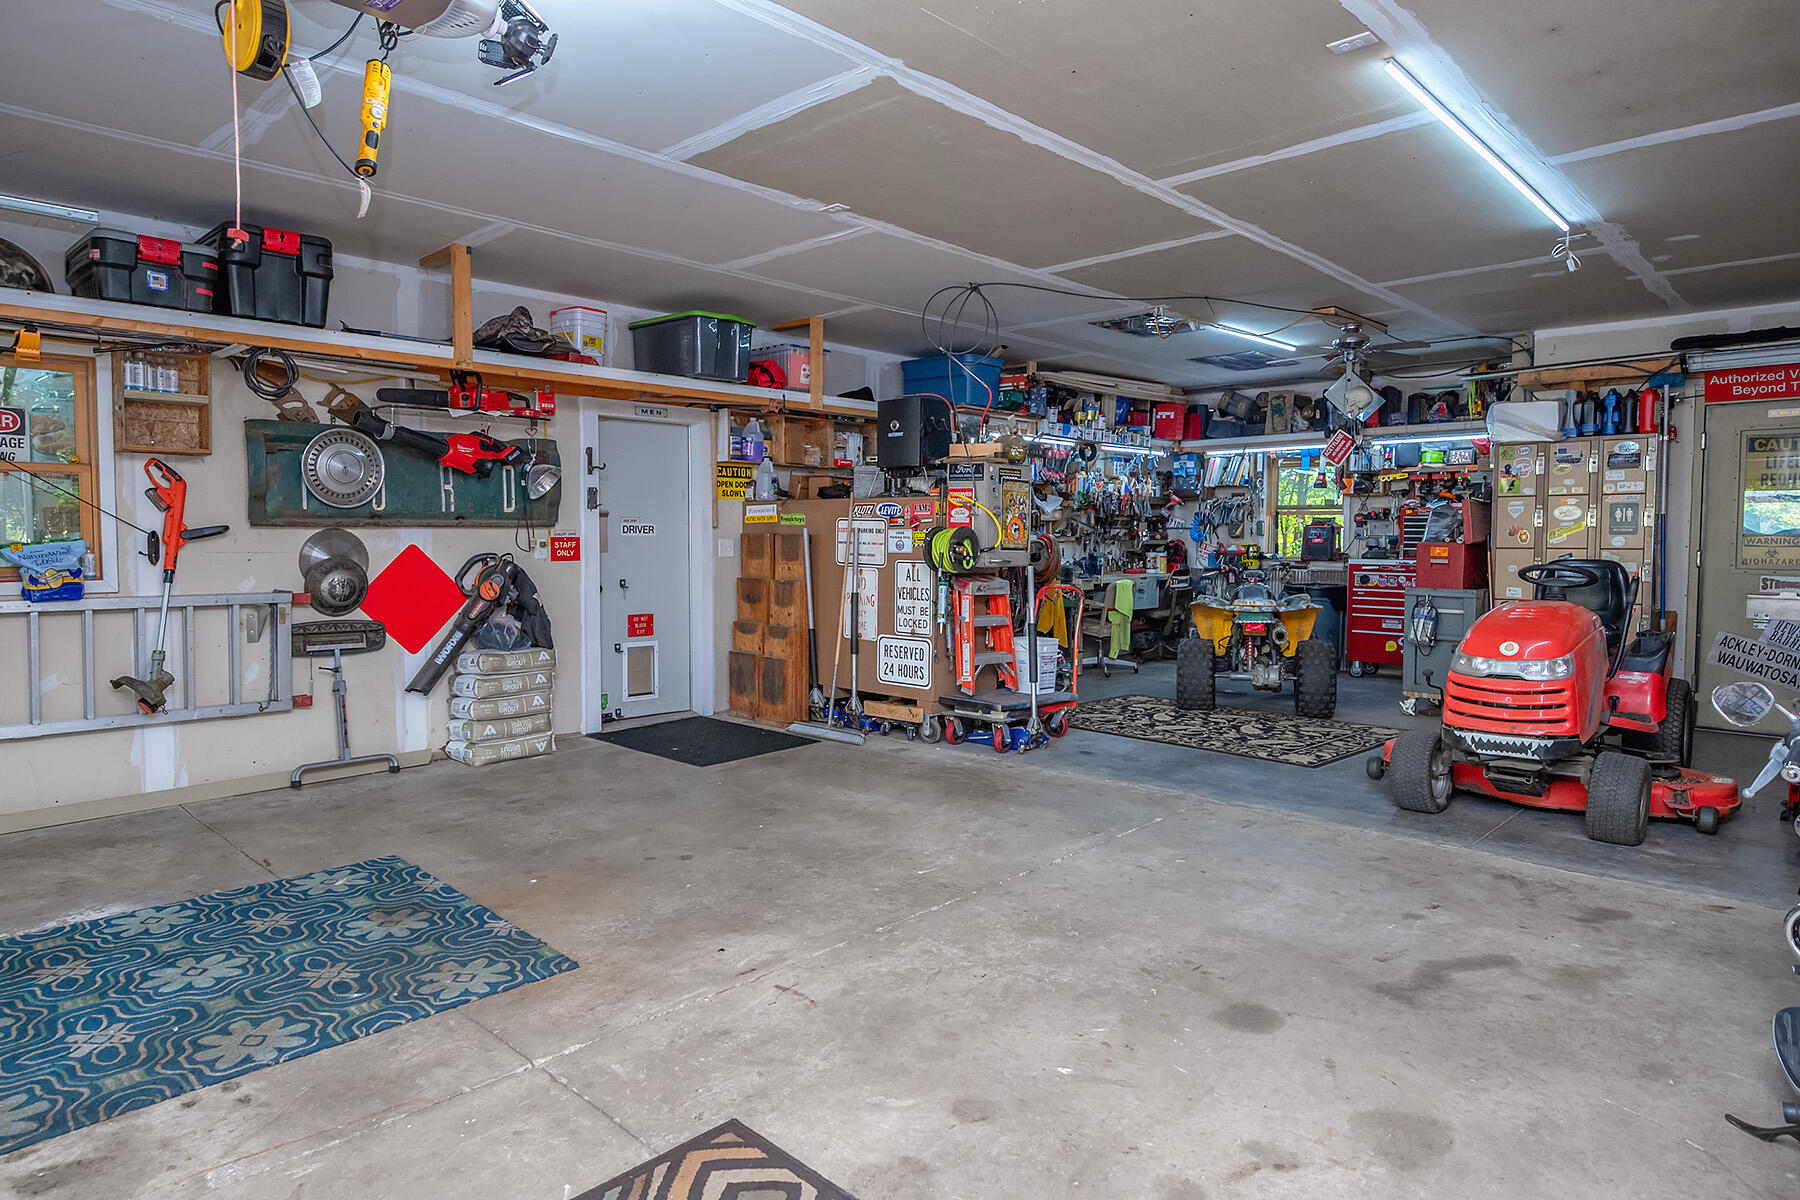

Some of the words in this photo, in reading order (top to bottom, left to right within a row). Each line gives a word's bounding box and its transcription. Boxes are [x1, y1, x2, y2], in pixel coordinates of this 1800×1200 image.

[1710, 370, 1785, 385] Authorized
[1789, 369, 1800, 379] V
[1732, 382, 1786, 396] Beyond
[0, 415, 13, 428] R
[717, 467, 752, 478] CAUTION
[622, 525, 655, 534] DRIVER
[554, 541, 577, 549] STAFF
[1746, 537, 1800, 545] WARNING
[556, 549, 575, 557] ONLY
[906, 568, 921, 582] ALL
[897, 587, 930, 602] VEHICLES
[897, 605, 916, 616] MUST
[920, 606, 929, 616] BE
[898, 618, 928, 629] LOCKED
[884, 644, 925, 662] RESERVED
[1719, 635, 1800, 670] ACKLEY-DORN
[883, 662, 894, 676] 24
[898, 664, 924, 680] HOURS
[1717, 650, 1800, 690] WAUWATOSA,
